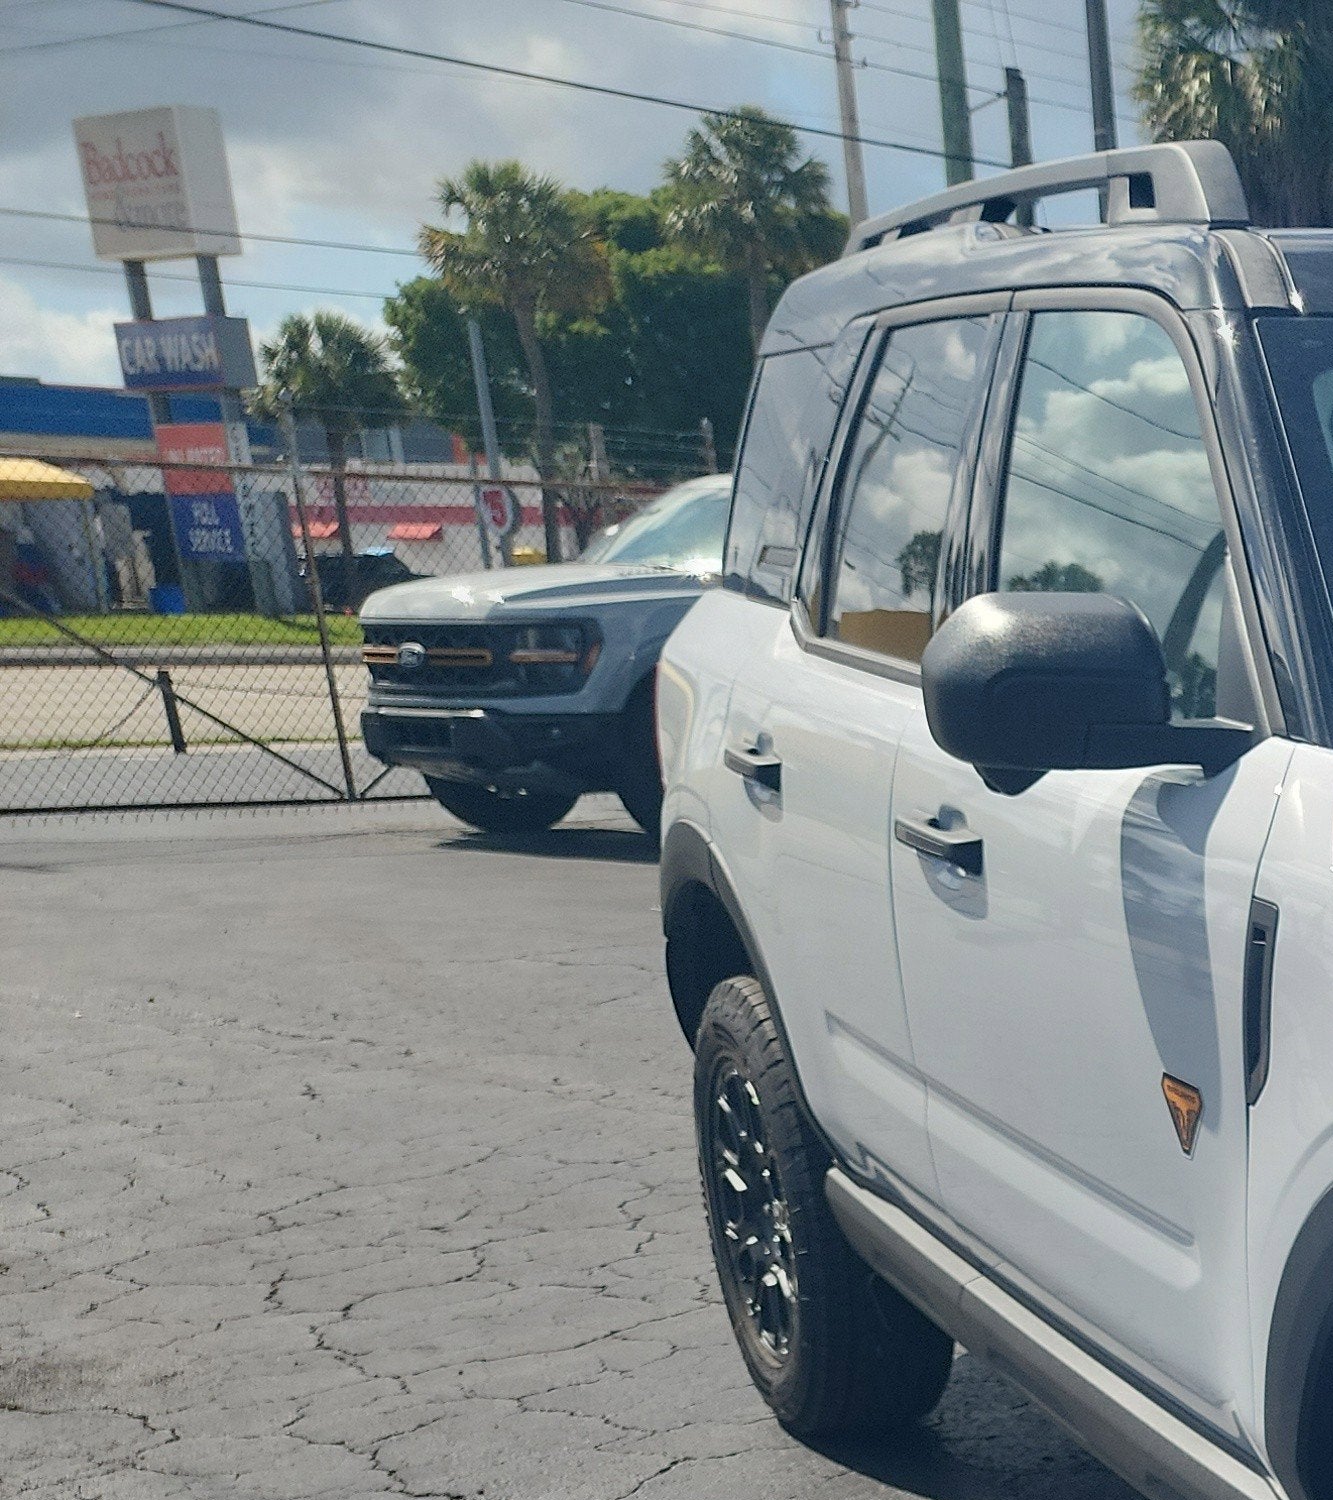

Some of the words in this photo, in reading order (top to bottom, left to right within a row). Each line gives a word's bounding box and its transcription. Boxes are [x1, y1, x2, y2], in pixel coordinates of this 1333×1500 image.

[78, 131, 179, 186] Badcock
[120, 337, 161, 375] CAR
[159, 331, 220, 373] WASH
